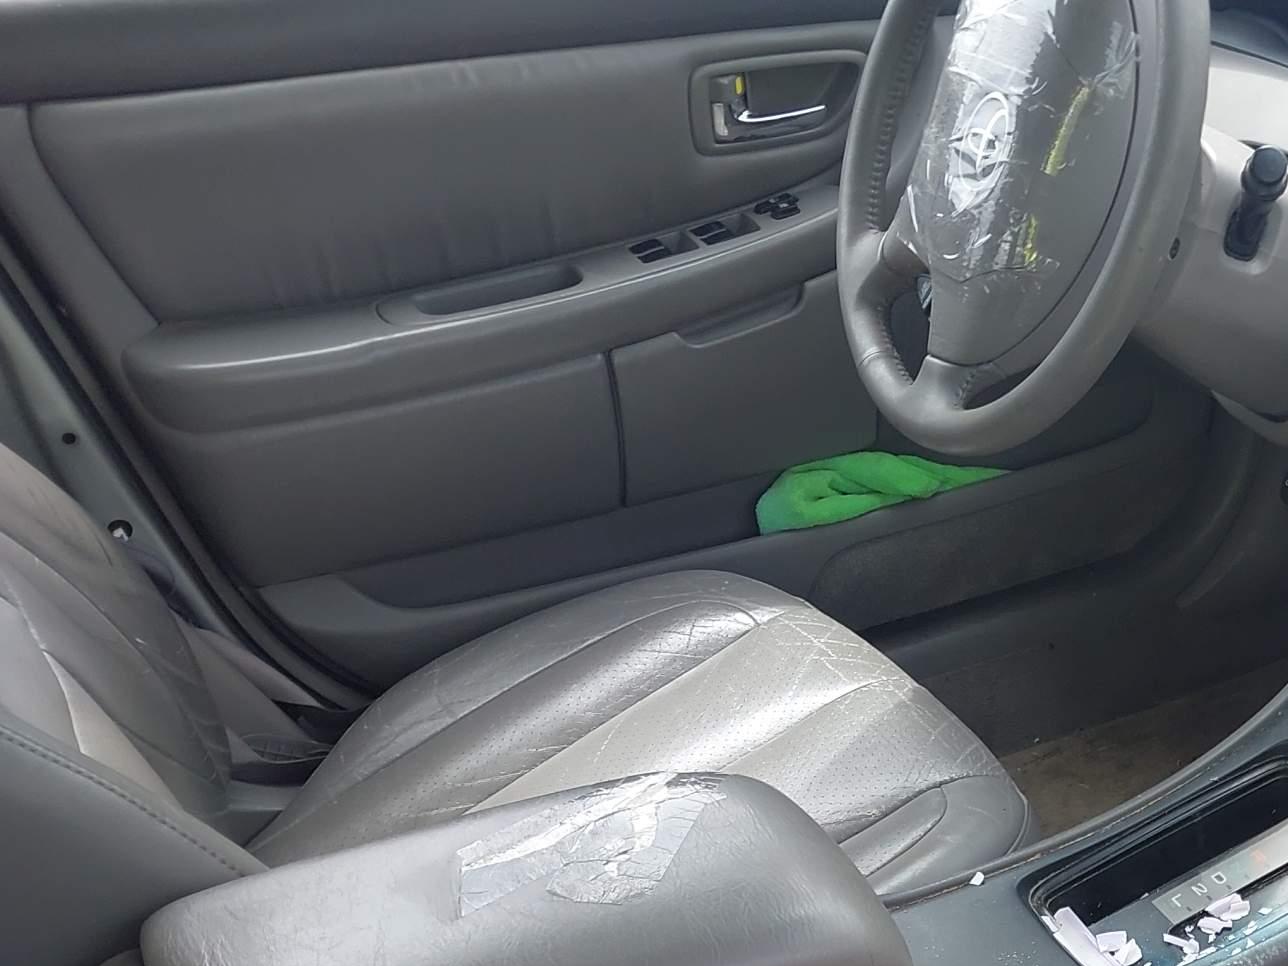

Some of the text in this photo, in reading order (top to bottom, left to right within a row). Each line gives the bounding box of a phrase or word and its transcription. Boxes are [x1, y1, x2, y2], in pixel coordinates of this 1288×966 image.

[1211, 871, 1227, 884] D
[1191, 883, 1208, 896] 2
[1171, 893, 1182, 907] L
